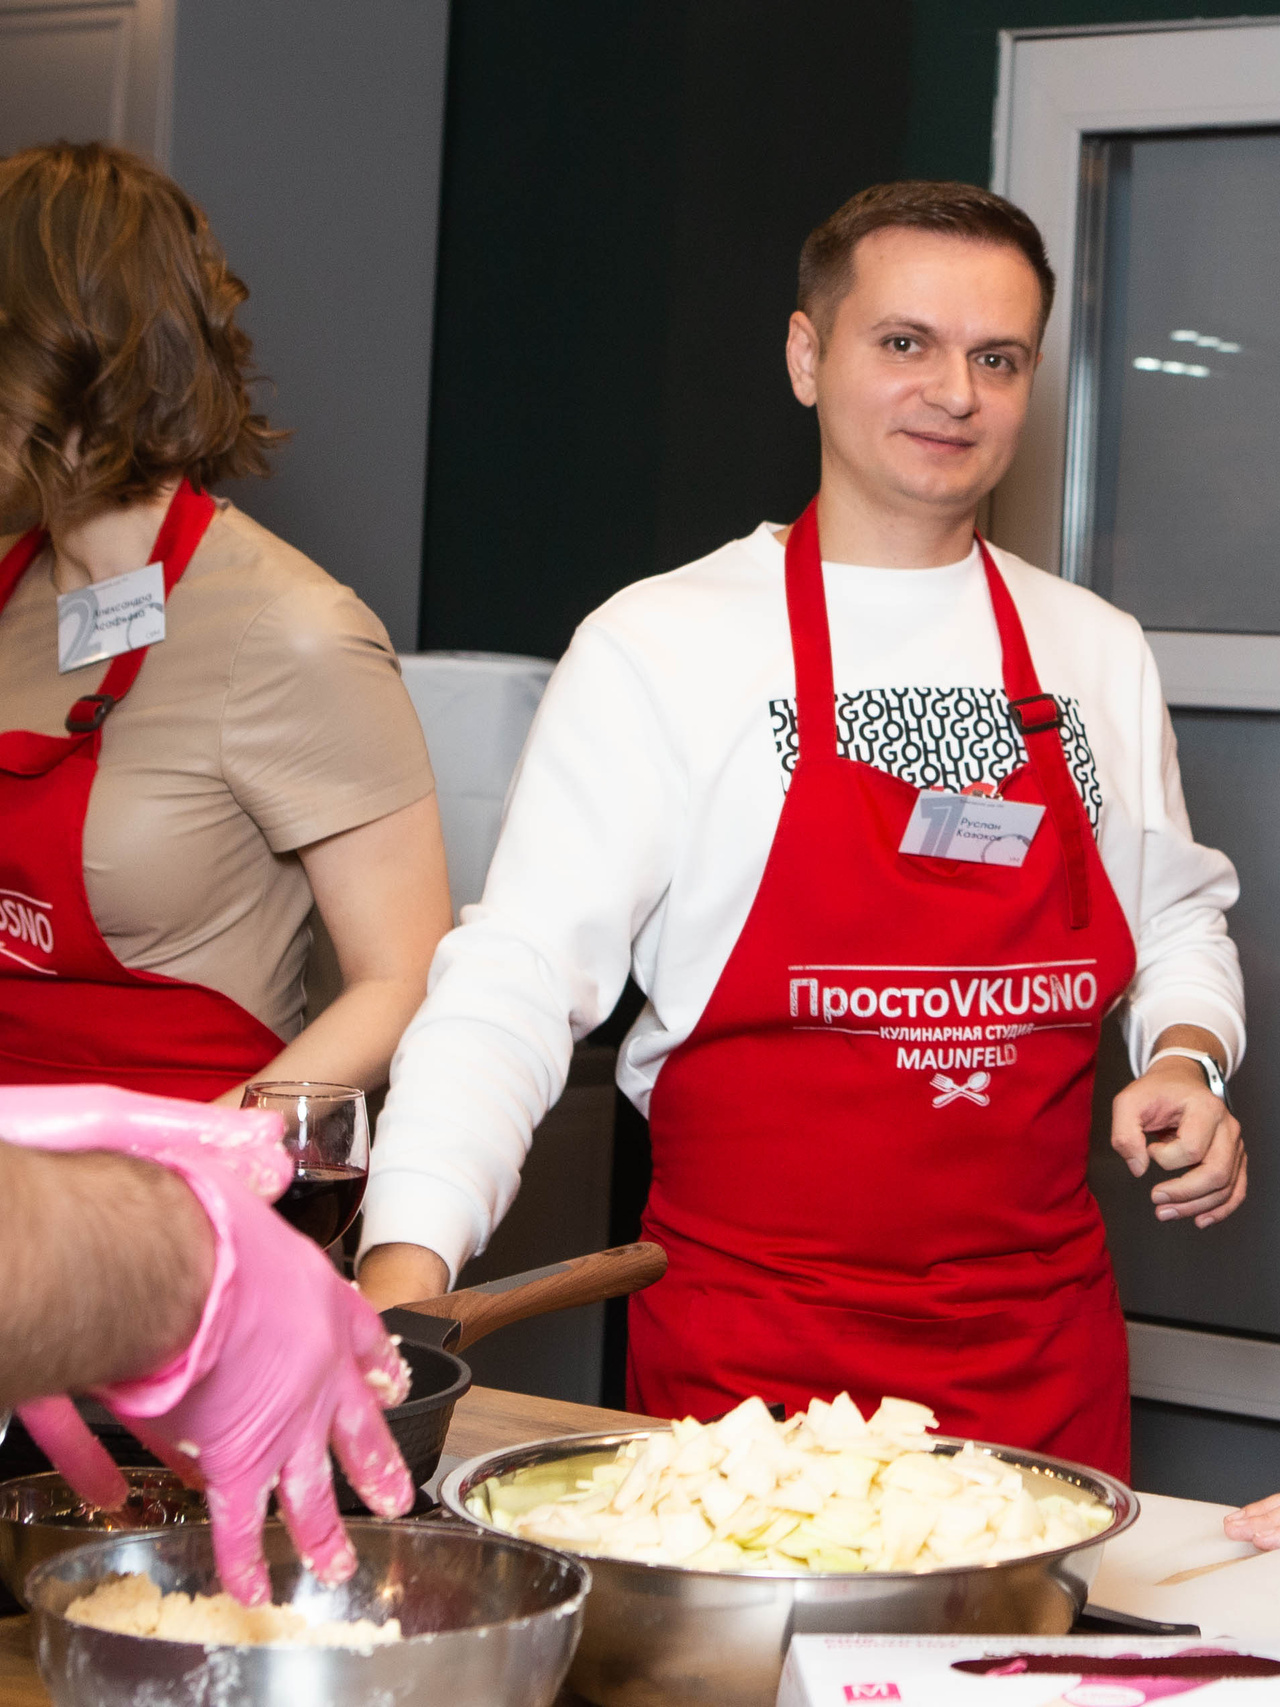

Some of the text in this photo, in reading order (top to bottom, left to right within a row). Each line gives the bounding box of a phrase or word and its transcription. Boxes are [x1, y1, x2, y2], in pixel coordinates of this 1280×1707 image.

[960, 817, 1001, 831] Руслан
[880, 1022, 1035, 1042] КУЛИНАРНАЯ СТУДИЯ
[896, 1043, 1018, 1070] MAUNFELD
